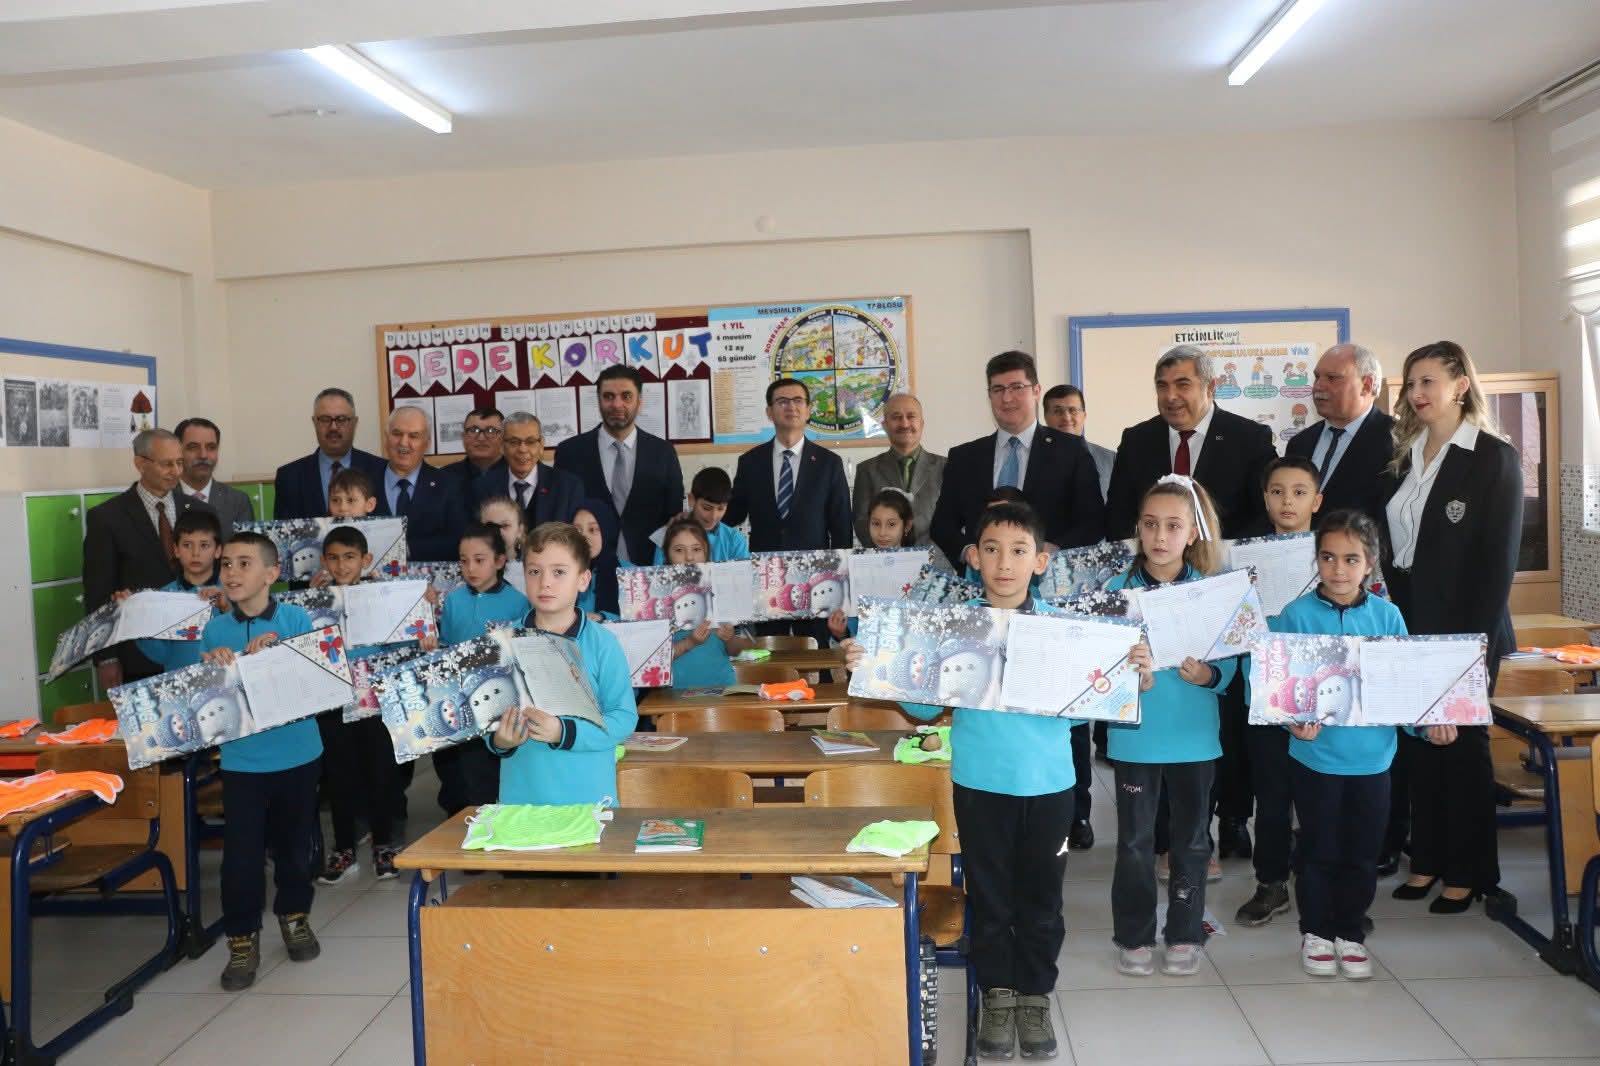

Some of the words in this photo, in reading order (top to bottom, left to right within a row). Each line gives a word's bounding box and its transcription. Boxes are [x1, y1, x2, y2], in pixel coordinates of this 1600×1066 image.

[730, 321, 745, 329] YIL
[1175, 328, 1224, 343] ETKİNLİK
[393, 345, 513, 380] DEDE
[530, 331, 712, 371] KORKUT
